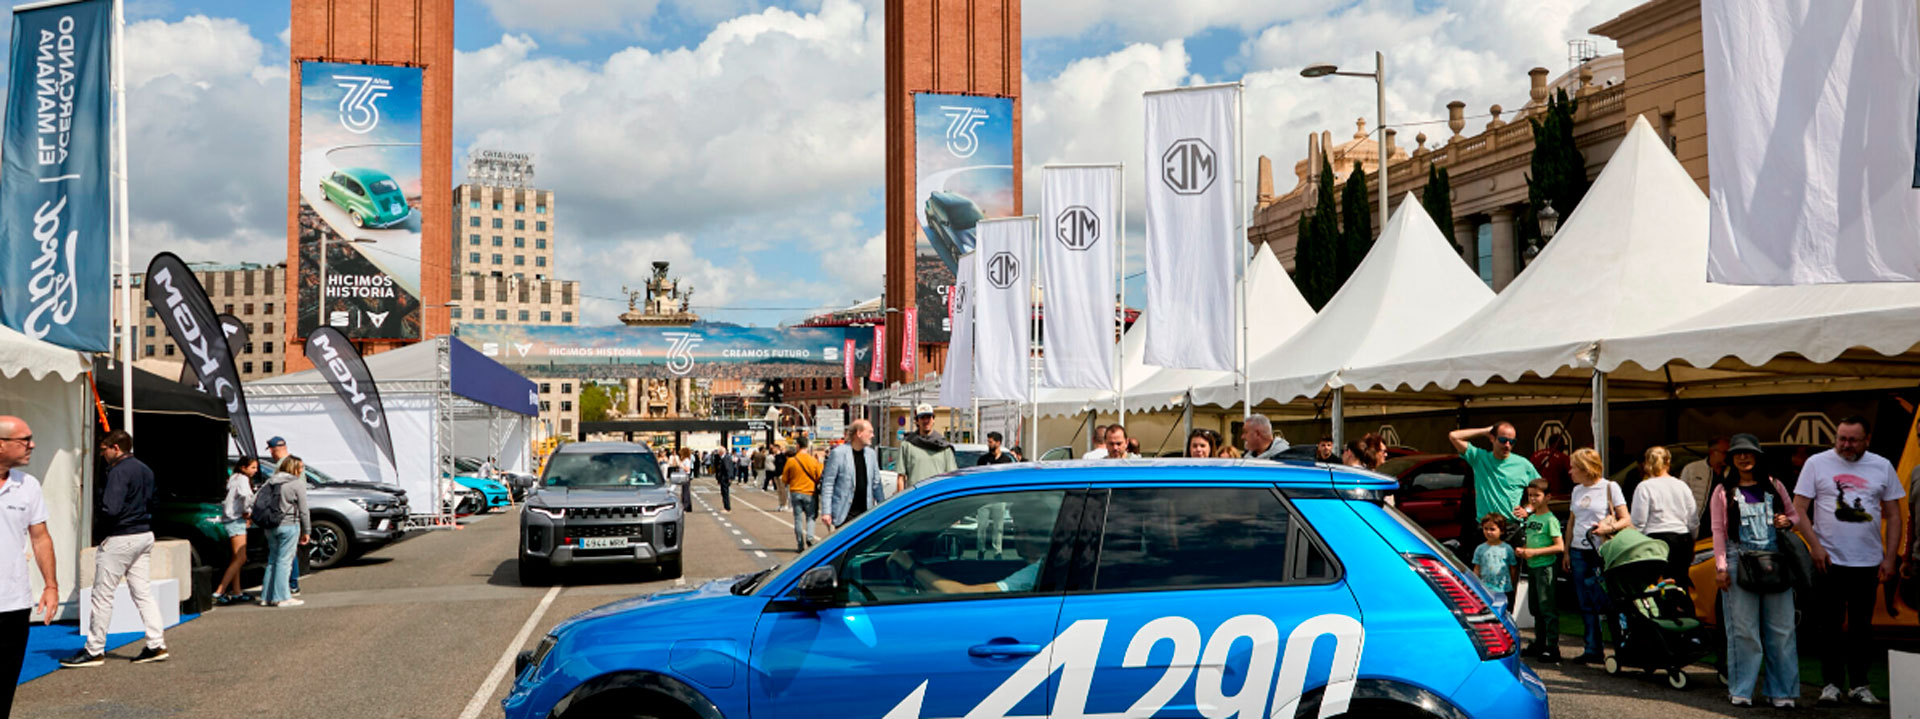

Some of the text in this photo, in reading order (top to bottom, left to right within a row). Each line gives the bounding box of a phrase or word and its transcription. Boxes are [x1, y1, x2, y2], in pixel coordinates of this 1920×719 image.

[328, 274, 393, 287] HICIMOS
[326, 286, 395, 298] HISTORIA
[548, 347, 643, 357] HICIMOS HISTORIA
[721, 348, 811, 358] CREAMOS FUTURO
